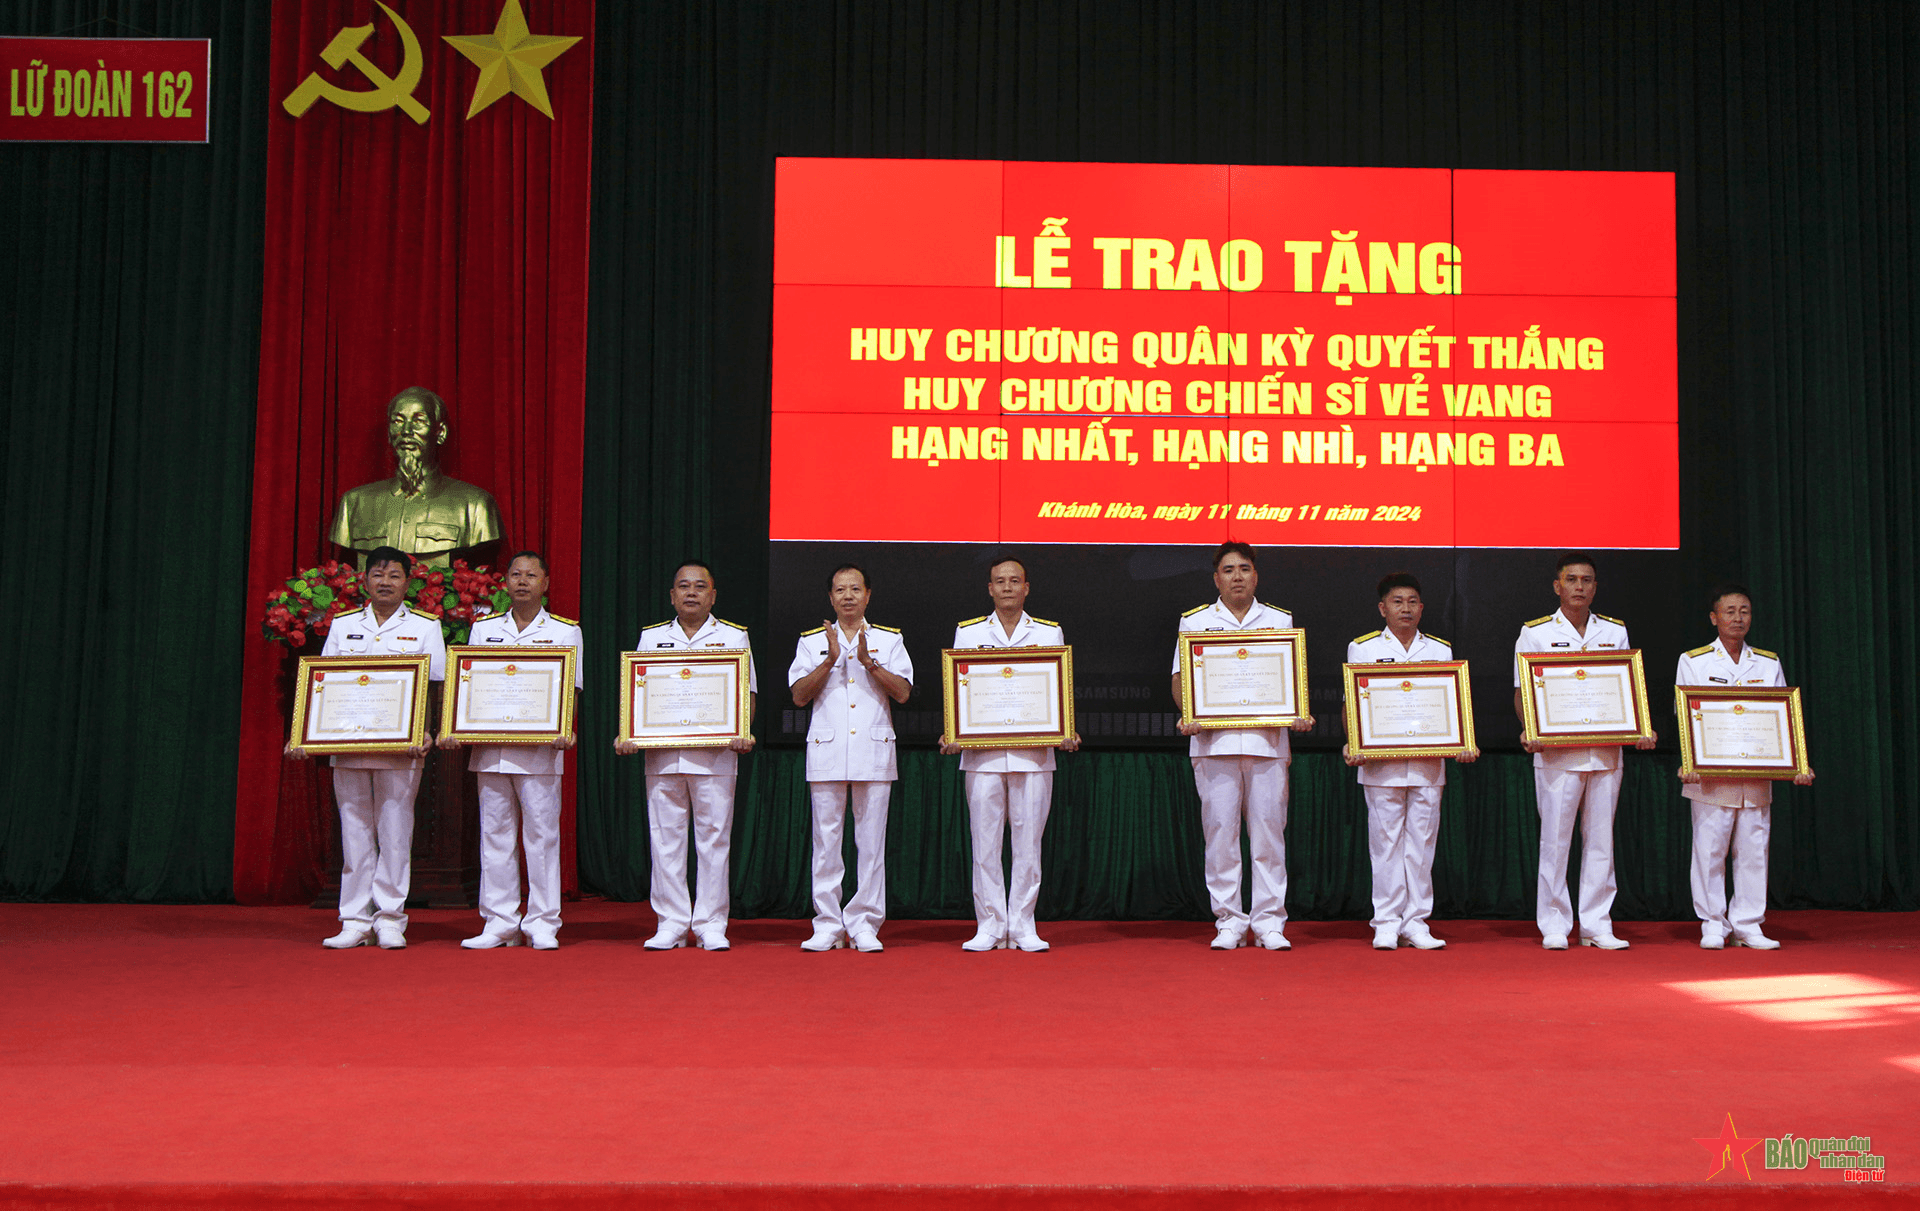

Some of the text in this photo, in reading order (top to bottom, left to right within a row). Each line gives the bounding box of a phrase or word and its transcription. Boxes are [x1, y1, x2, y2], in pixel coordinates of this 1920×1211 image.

[11, 60, 193, 118] LỮ ĐOÀN 162
[995, 217, 1463, 305] LỄ TRAO TẶNG
[851, 325, 1604, 371] HUY CHƯƠNG QUÂN KỲ QUYẾT THẮNG
[904, 371, 1551, 418] HUY CHƯƠNG CHIẾN SĨ VẺ VANG
[892, 414, 1565, 473] HẠNG NHẤT, HẠNG NHÌ, HẠNG BA
[1038, 502, 1423, 522] Khánh Hòa, ngày 11 tháng 11 năm 2024
[1074, 686, 1151, 700] SAMSUNG
